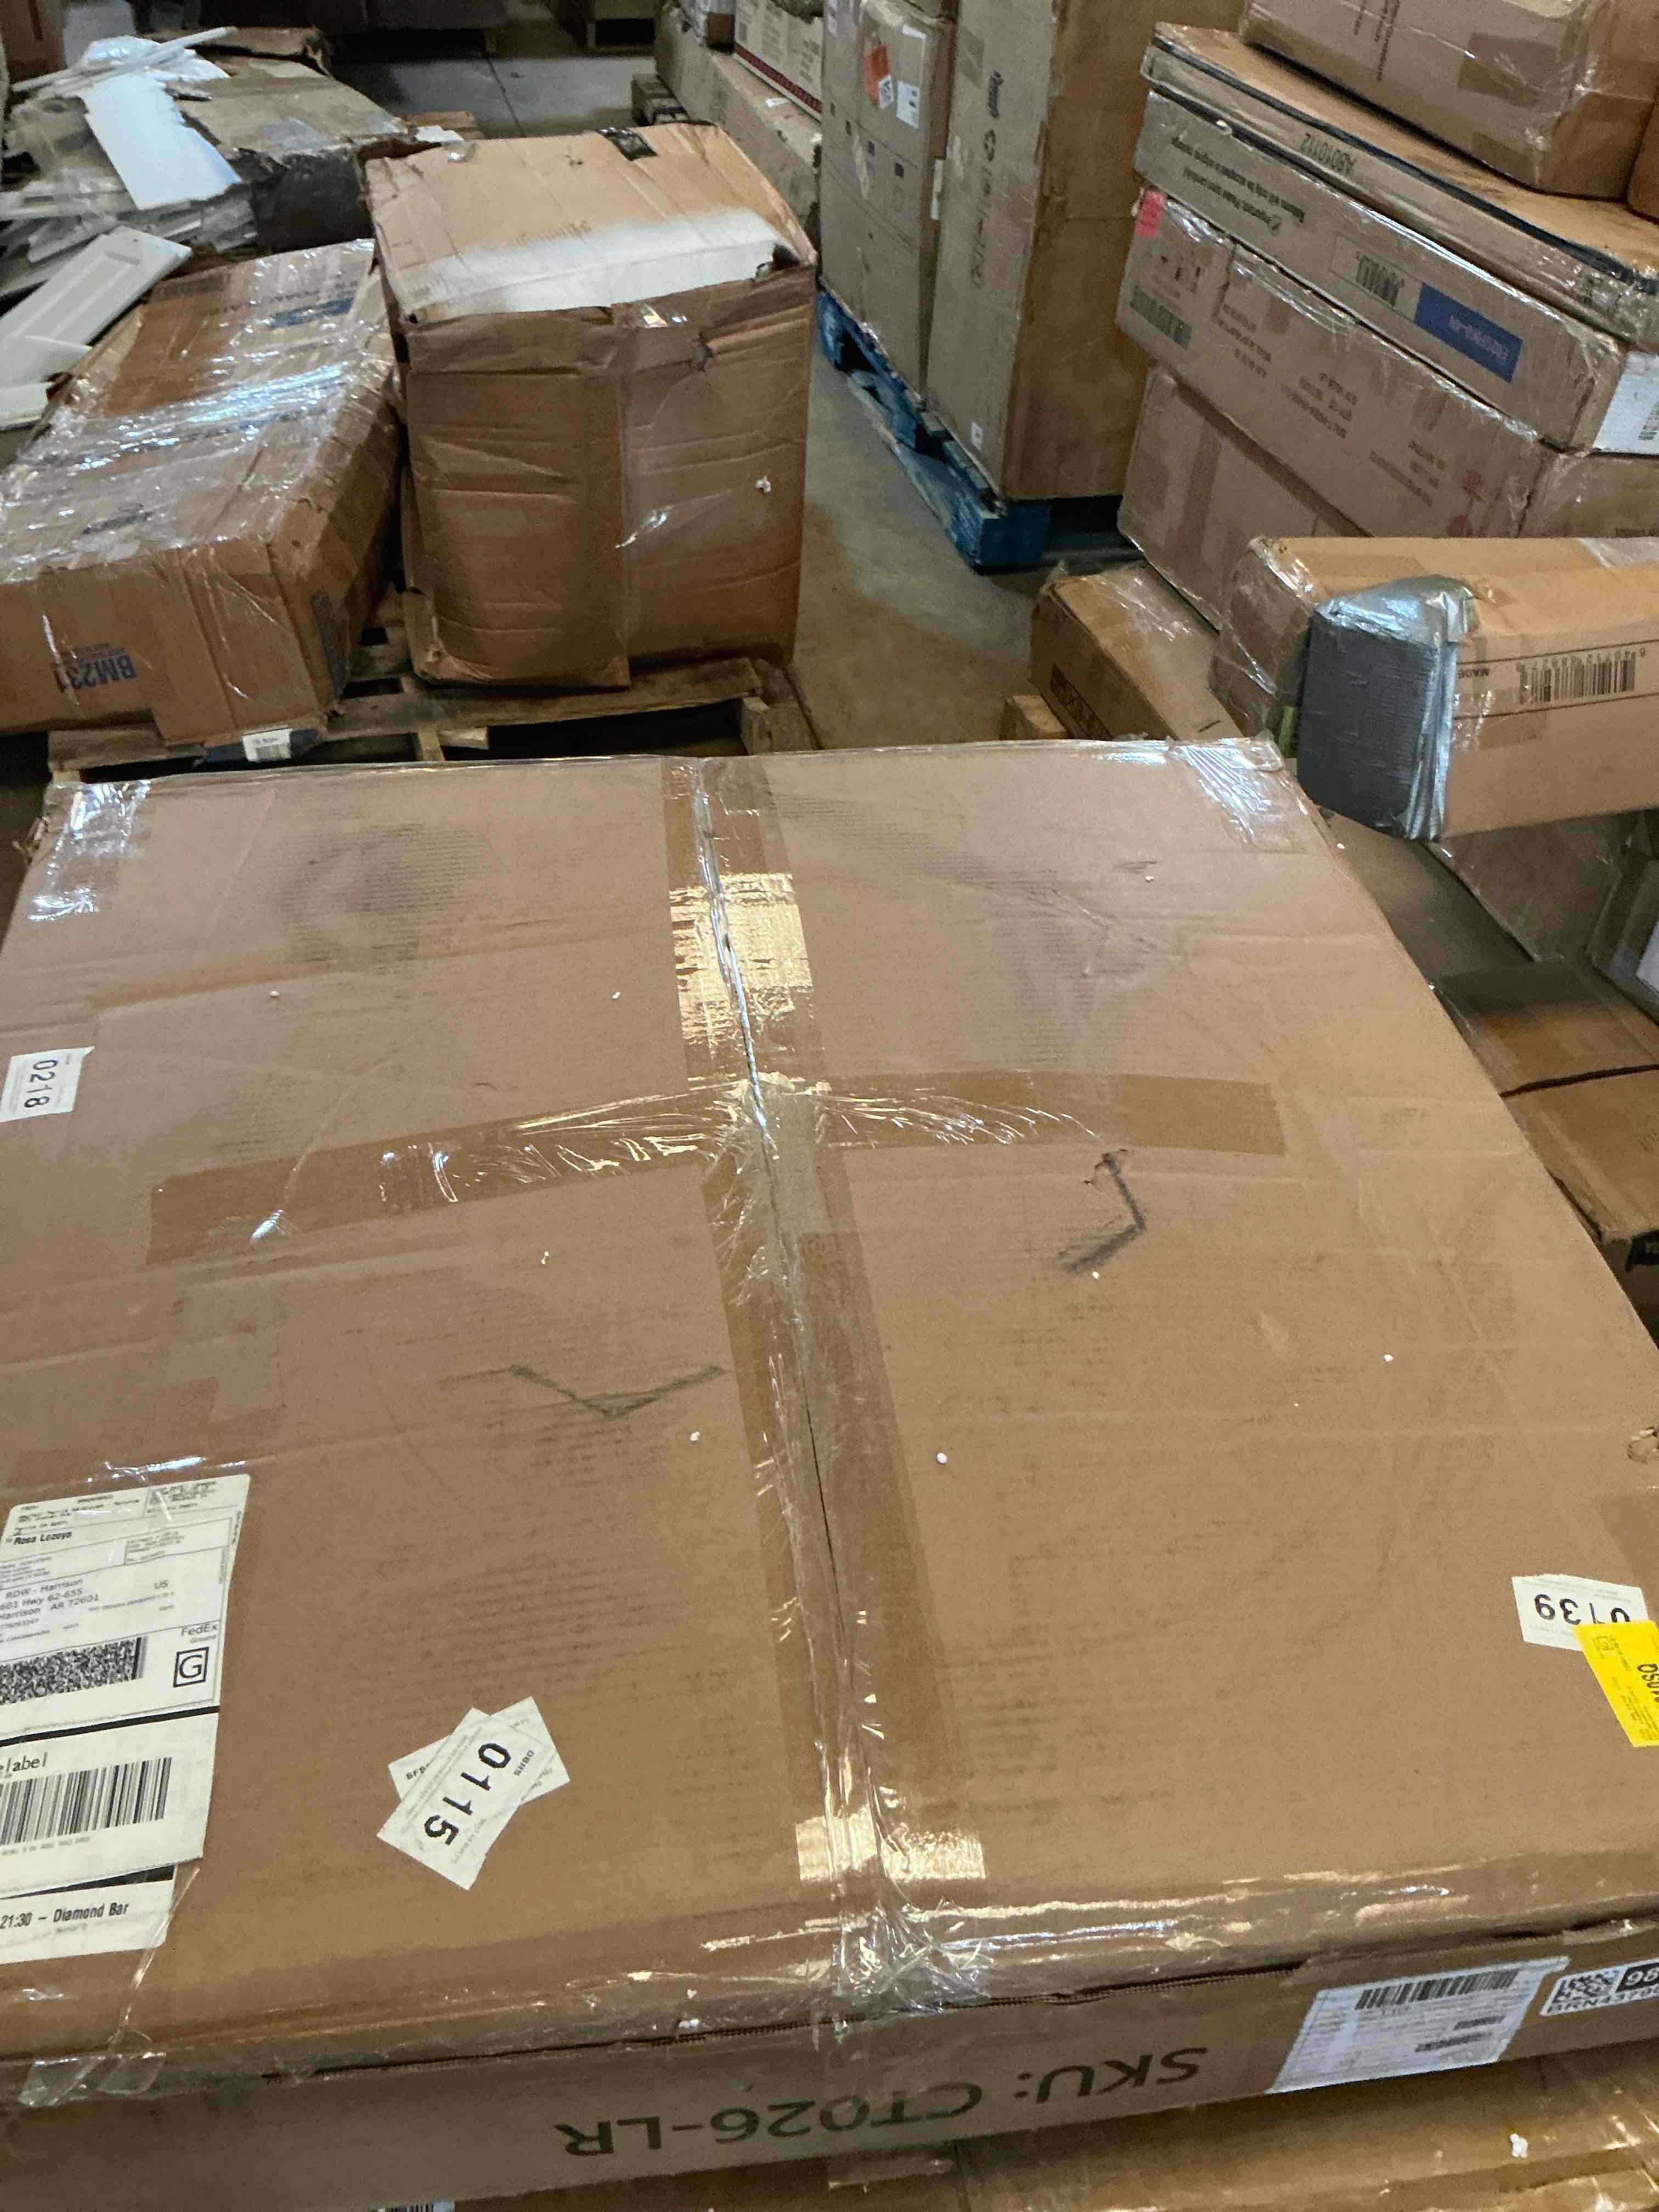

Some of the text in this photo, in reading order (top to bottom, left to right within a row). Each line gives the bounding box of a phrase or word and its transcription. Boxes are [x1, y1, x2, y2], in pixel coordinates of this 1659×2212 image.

[24, 1059, 58, 1108] 0218
[181, 1623, 218, 1636] FedEx
[179, 1654, 202, 1679] G
[424, 1742, 511, 1846] 0115
[53, 1903, 105, 1923] Diamond
[109, 1902, 129, 1916] Bar
[554, 2047, 1208, 2156] SKU: CT026-LR
